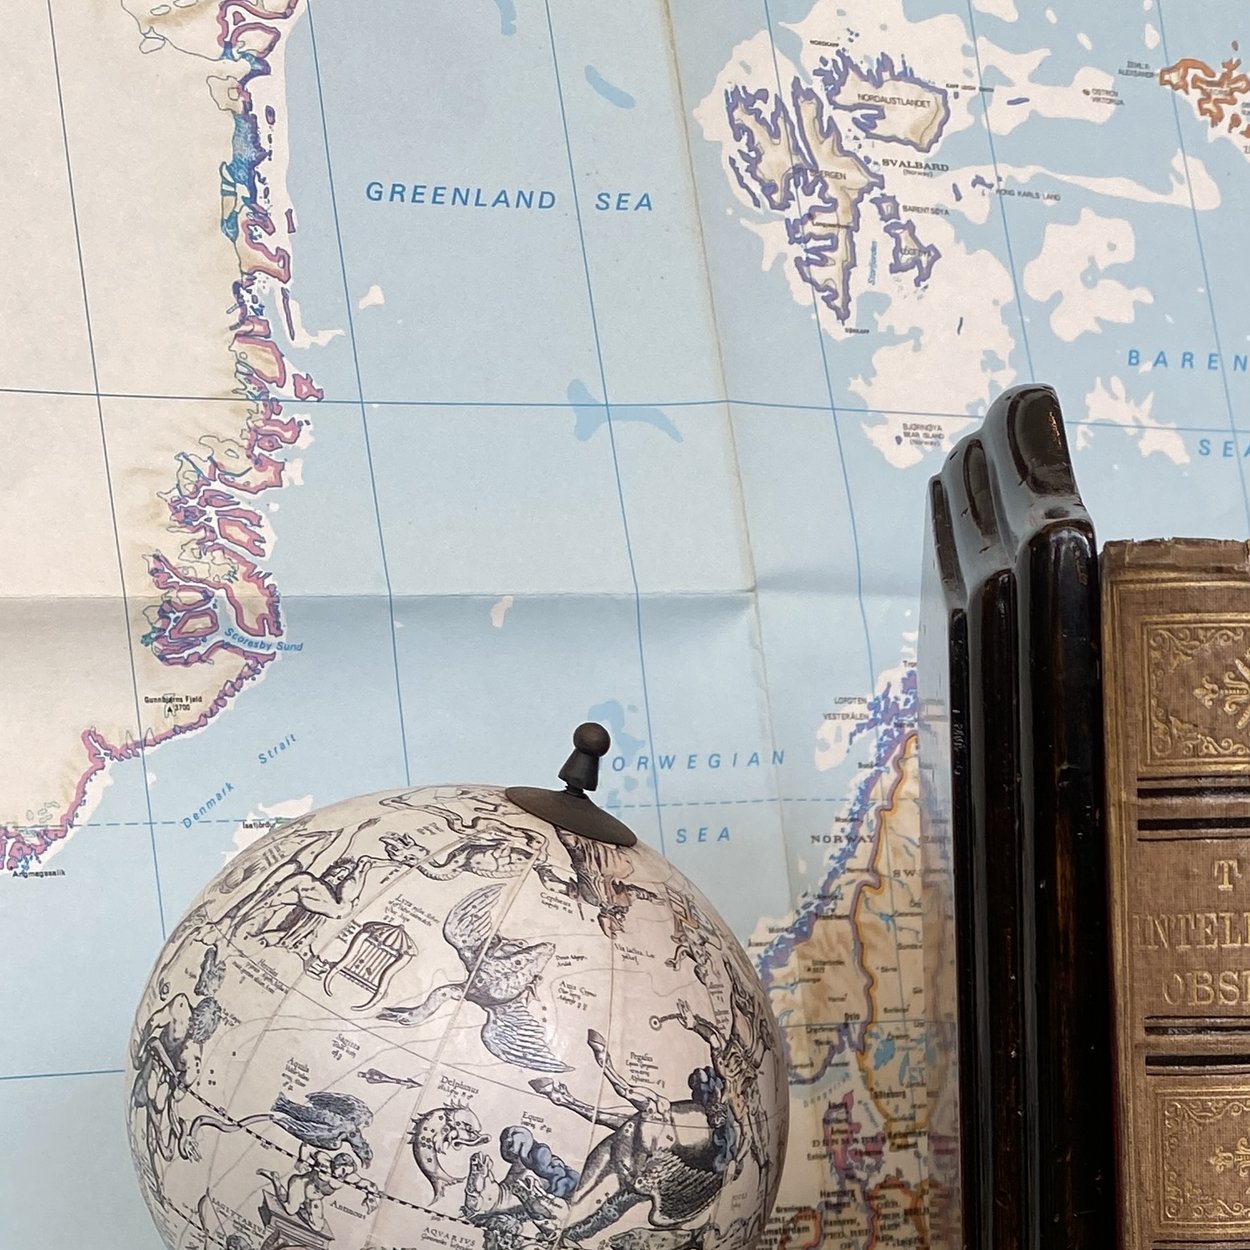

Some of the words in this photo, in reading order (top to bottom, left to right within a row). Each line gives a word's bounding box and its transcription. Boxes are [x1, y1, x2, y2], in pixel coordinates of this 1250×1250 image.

[857, 93, 931, 107] NORDAUSTLANDET
[882, 159, 949, 172] SVALBARD
[365, 182, 557, 210] GREENLAND
[595, 191, 654, 211] SEA
[225, 628, 271, 651] Scoresby
[276, 641, 303, 651] Sund
[258, 733, 297, 764] Strait
[612, 750, 785, 772] ORWEGIAN
[182, 782, 234, 829] Denmark
[676, 826, 731, 844] SEA
[811, 835, 875, 844] NORWAY
